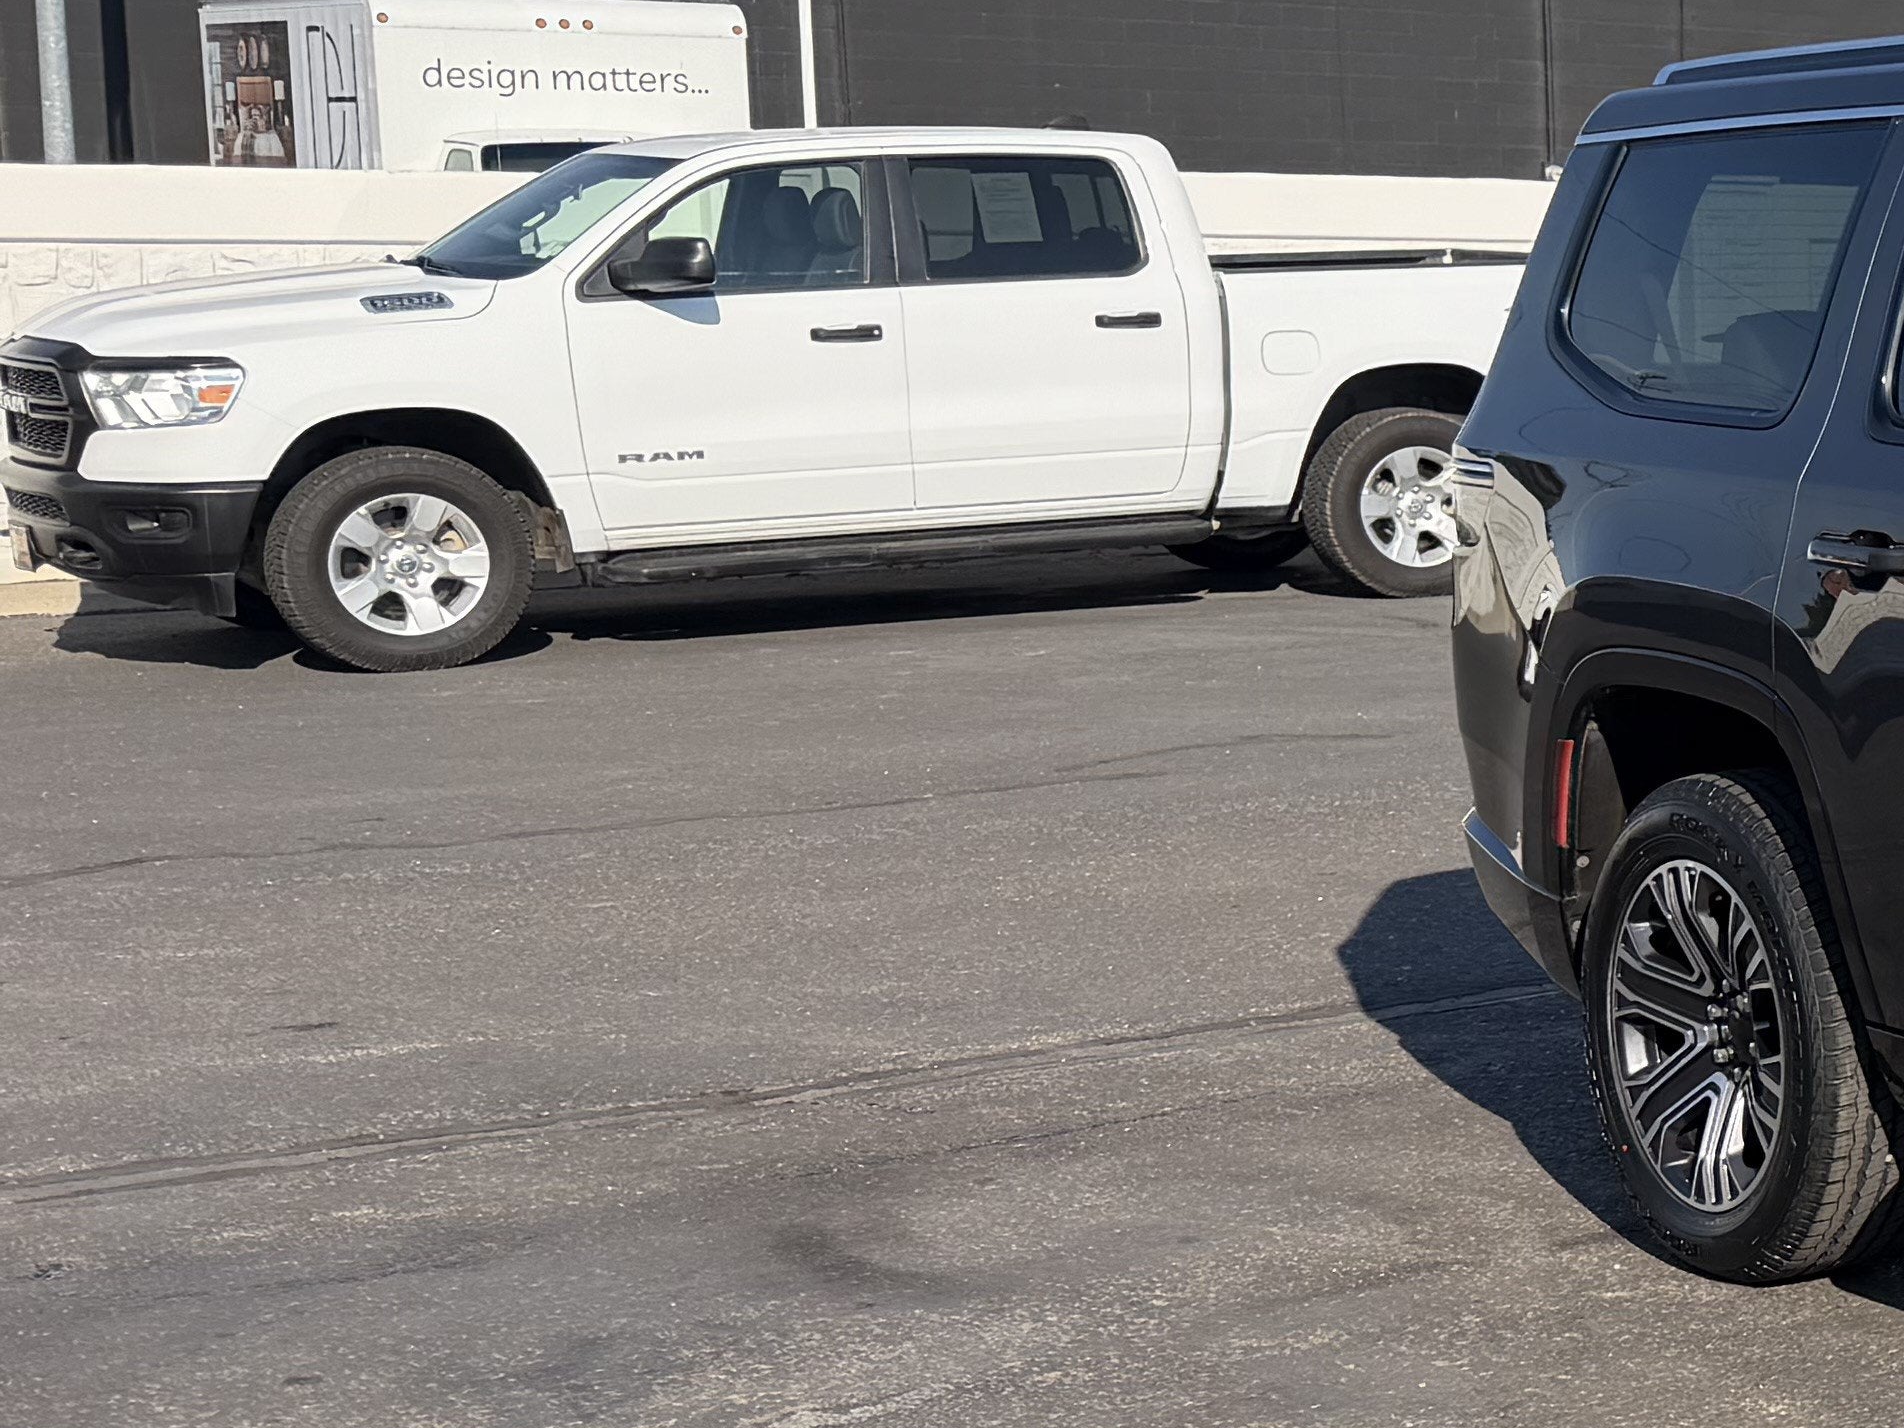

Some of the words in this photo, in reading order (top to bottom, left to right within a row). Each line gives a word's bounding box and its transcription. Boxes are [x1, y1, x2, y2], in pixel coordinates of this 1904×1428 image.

[422, 58, 540, 97] design
[552, 67, 710, 94] matters...
[617, 450, 705, 464] RAM
